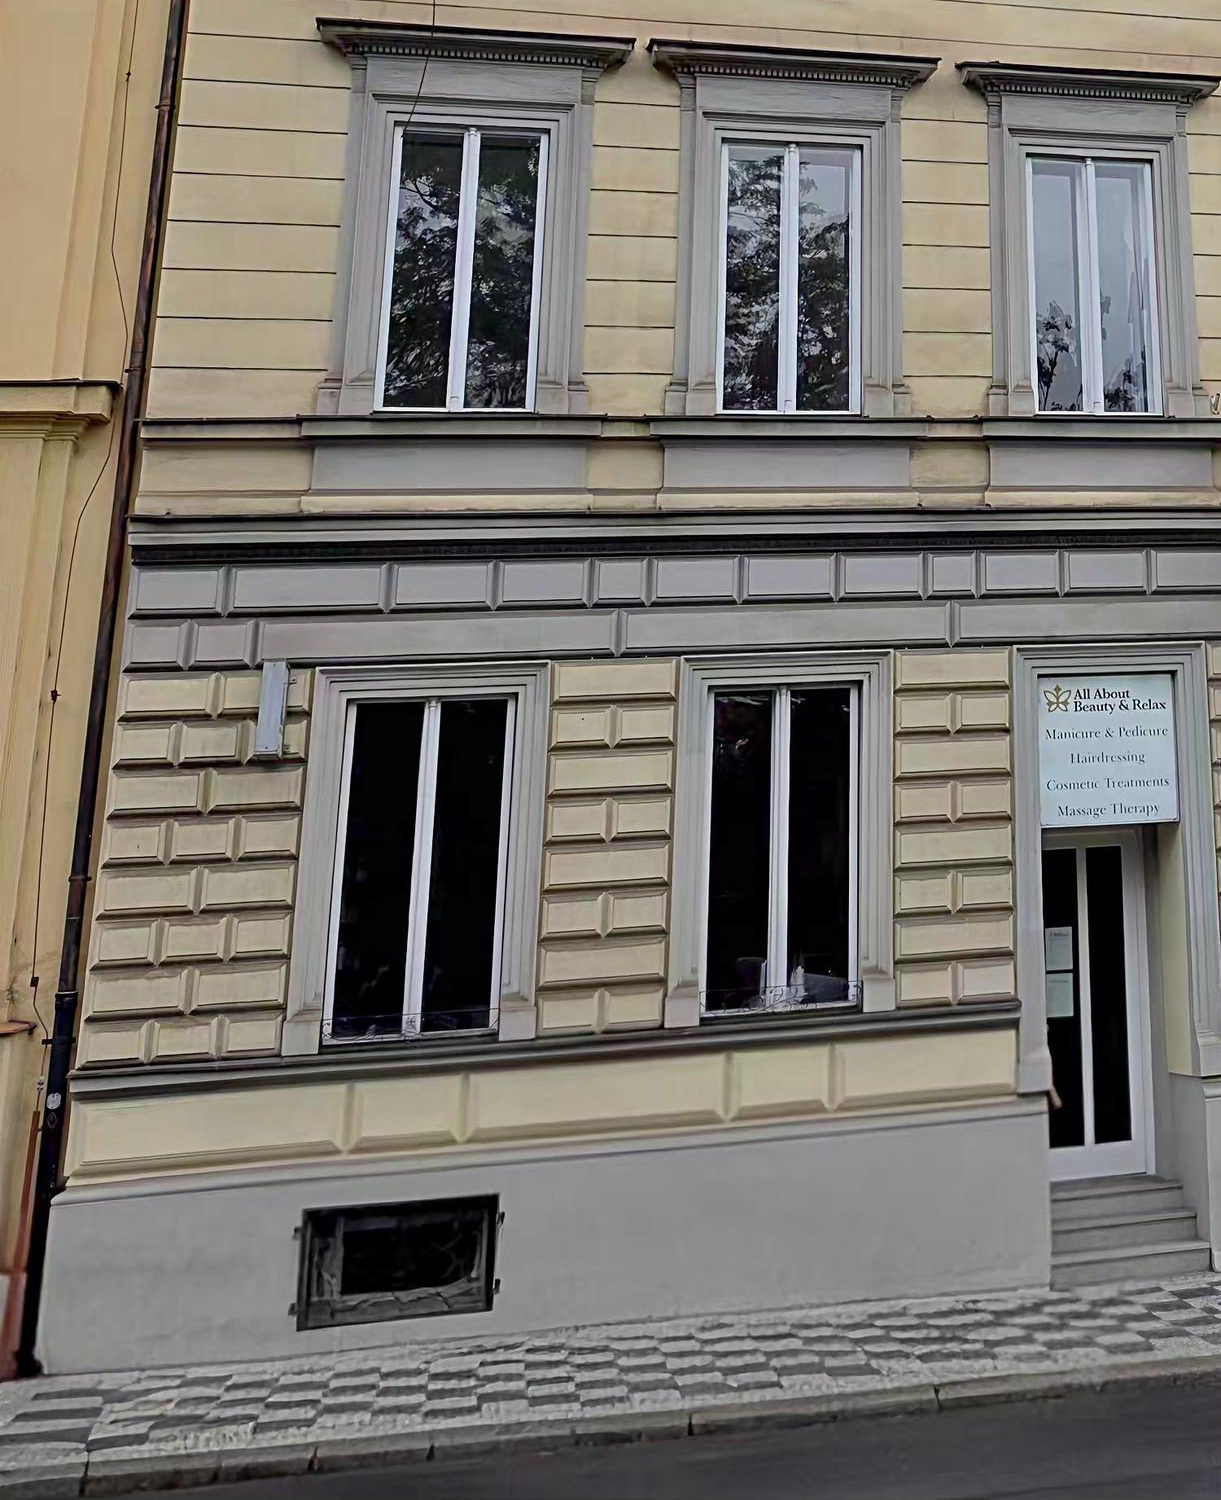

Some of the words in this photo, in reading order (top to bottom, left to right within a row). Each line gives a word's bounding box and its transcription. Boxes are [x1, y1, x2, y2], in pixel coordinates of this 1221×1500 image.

[1074, 688, 1090, 700] All
[1094, 688, 1130, 700] About
[1074, 700, 1115, 714] Beauty
[1119, 700, 1130, 711] &
[1133, 699, 1166, 711] Relax
[1045, 728, 1100, 740] Manicure
[1104, 727, 1114, 738] &
[1118, 726, 1168, 738] Pedicure
[1070, 751, 1145, 764] Hairdressing
[1046, 779, 1099, 791] Cosmetic
[1104, 777, 1170, 789] Treatments
[1057, 805, 1106, 819] Massage
[1110, 803, 1160, 817] Therapy
